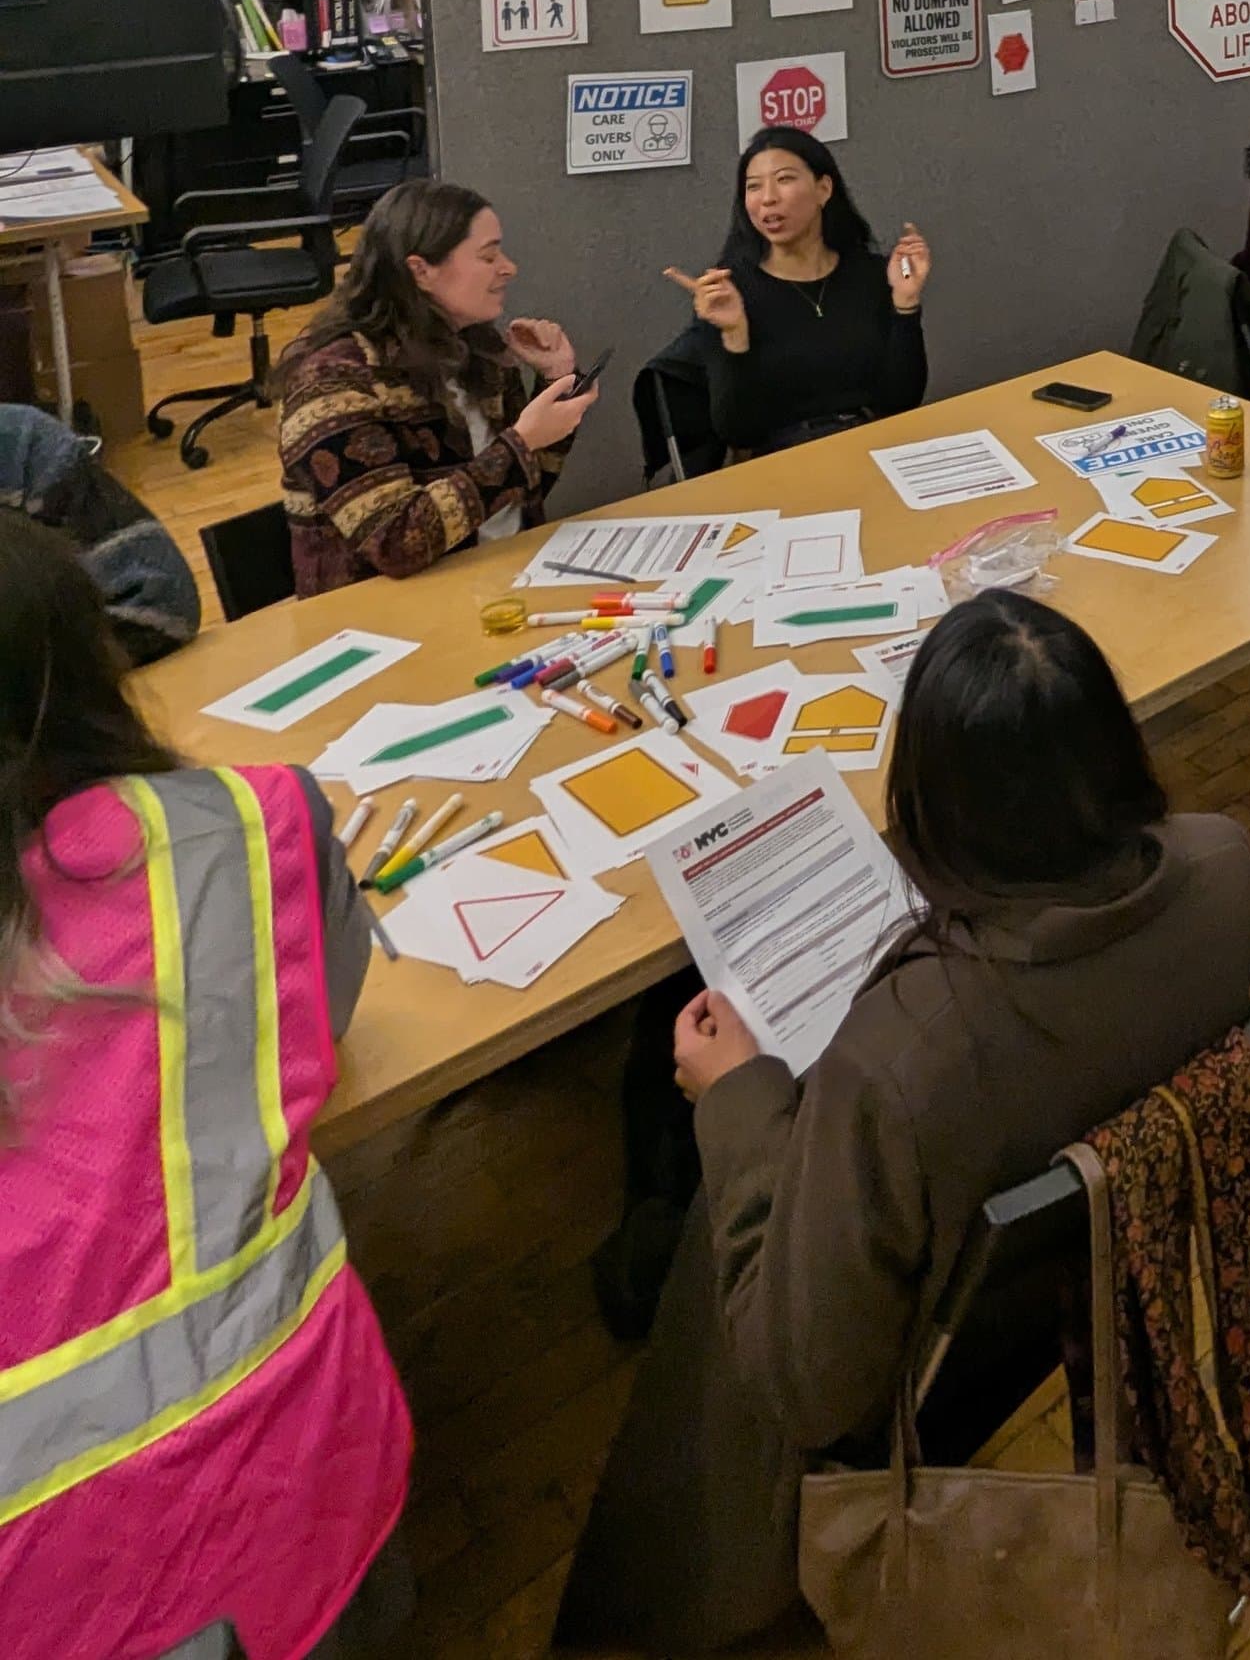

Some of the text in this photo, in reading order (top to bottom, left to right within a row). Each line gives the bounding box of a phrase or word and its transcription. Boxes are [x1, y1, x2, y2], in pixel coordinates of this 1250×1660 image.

[904, 10, 960, 33] ALLOWED
[891, 30, 973, 49] VIOLATORS WILL BE
[905, 43, 960, 59] PROSECUTED
[577, 84, 683, 110] NOTICE
[764, 85, 823, 120] STOP
[592, 113, 625, 126] CARE
[585, 131, 632, 145] GIVERS
[592, 149, 626, 162] ONLY
[1124, 422, 1171, 437] GIVER
[1126, 417, 1154, 428] ONL
[1087, 434, 1202, 470] NOTICE
[693, 821, 729, 851] NYC
